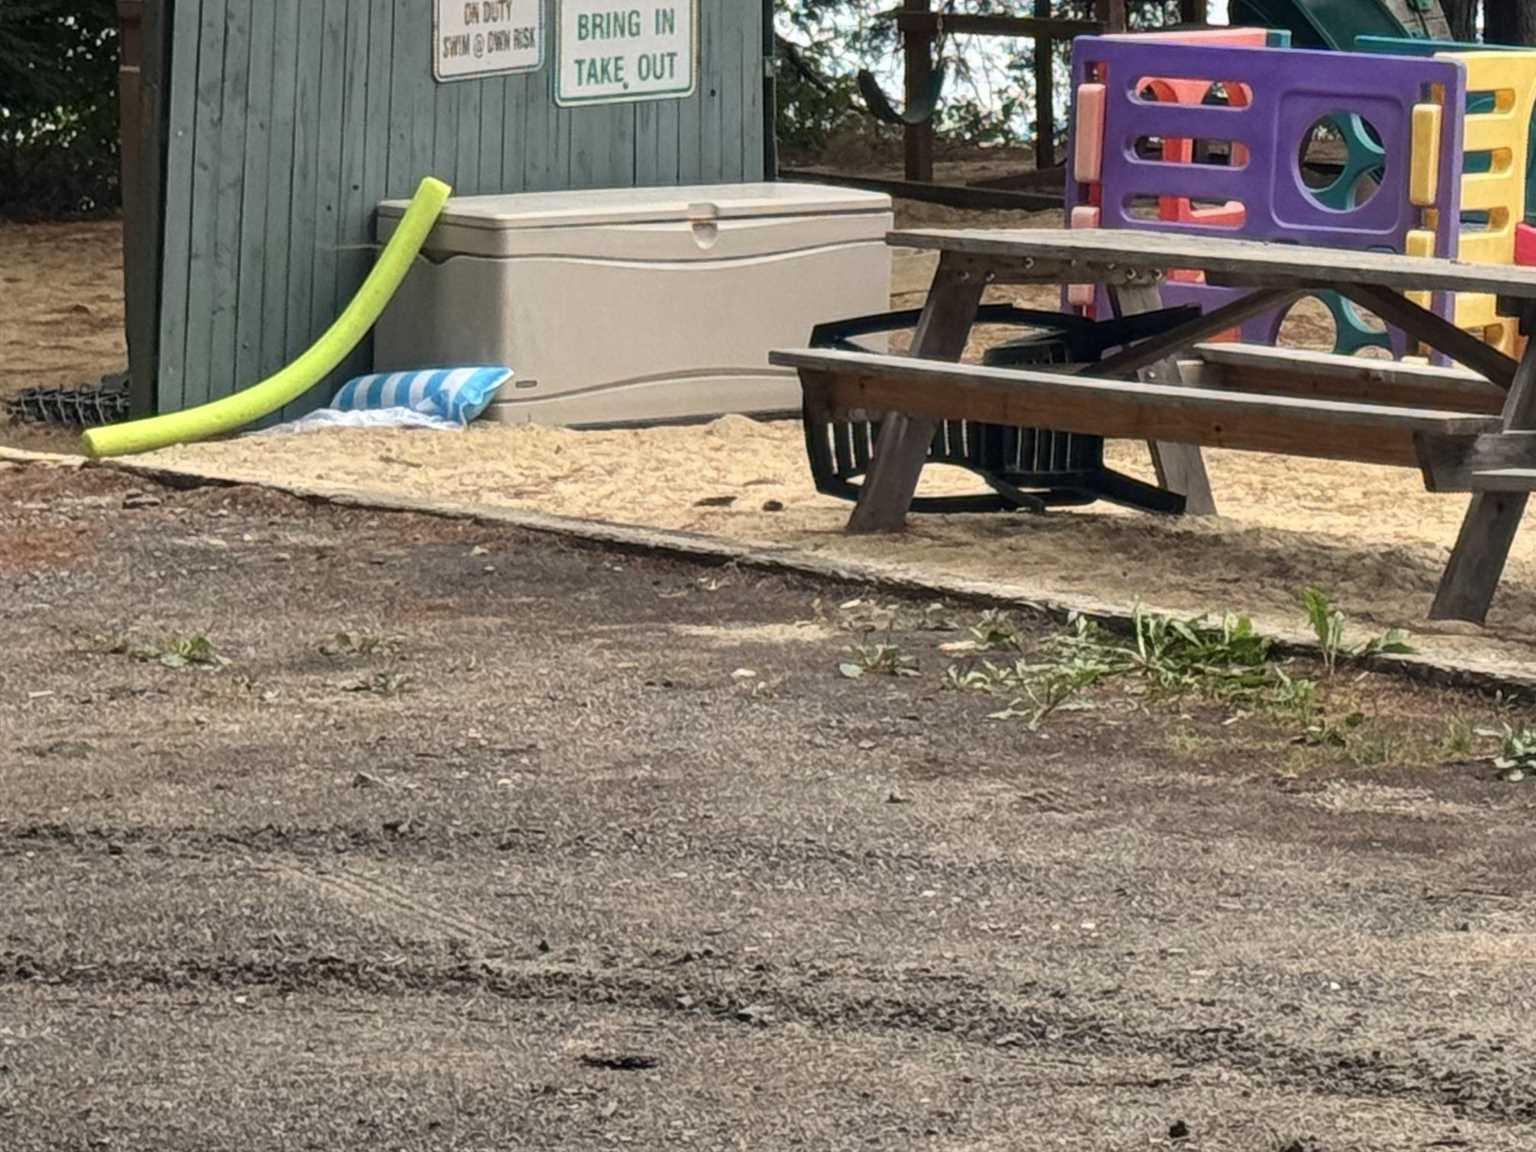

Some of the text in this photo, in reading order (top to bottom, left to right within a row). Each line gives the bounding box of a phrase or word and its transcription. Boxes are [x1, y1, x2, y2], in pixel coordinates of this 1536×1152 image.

[464, 2, 480, 26] ON
[577, 8, 675, 41] BRING IN
[443, 26, 536, 59] SWIM @ OWN RISK
[574, 52, 678, 86] TAKE OUT
